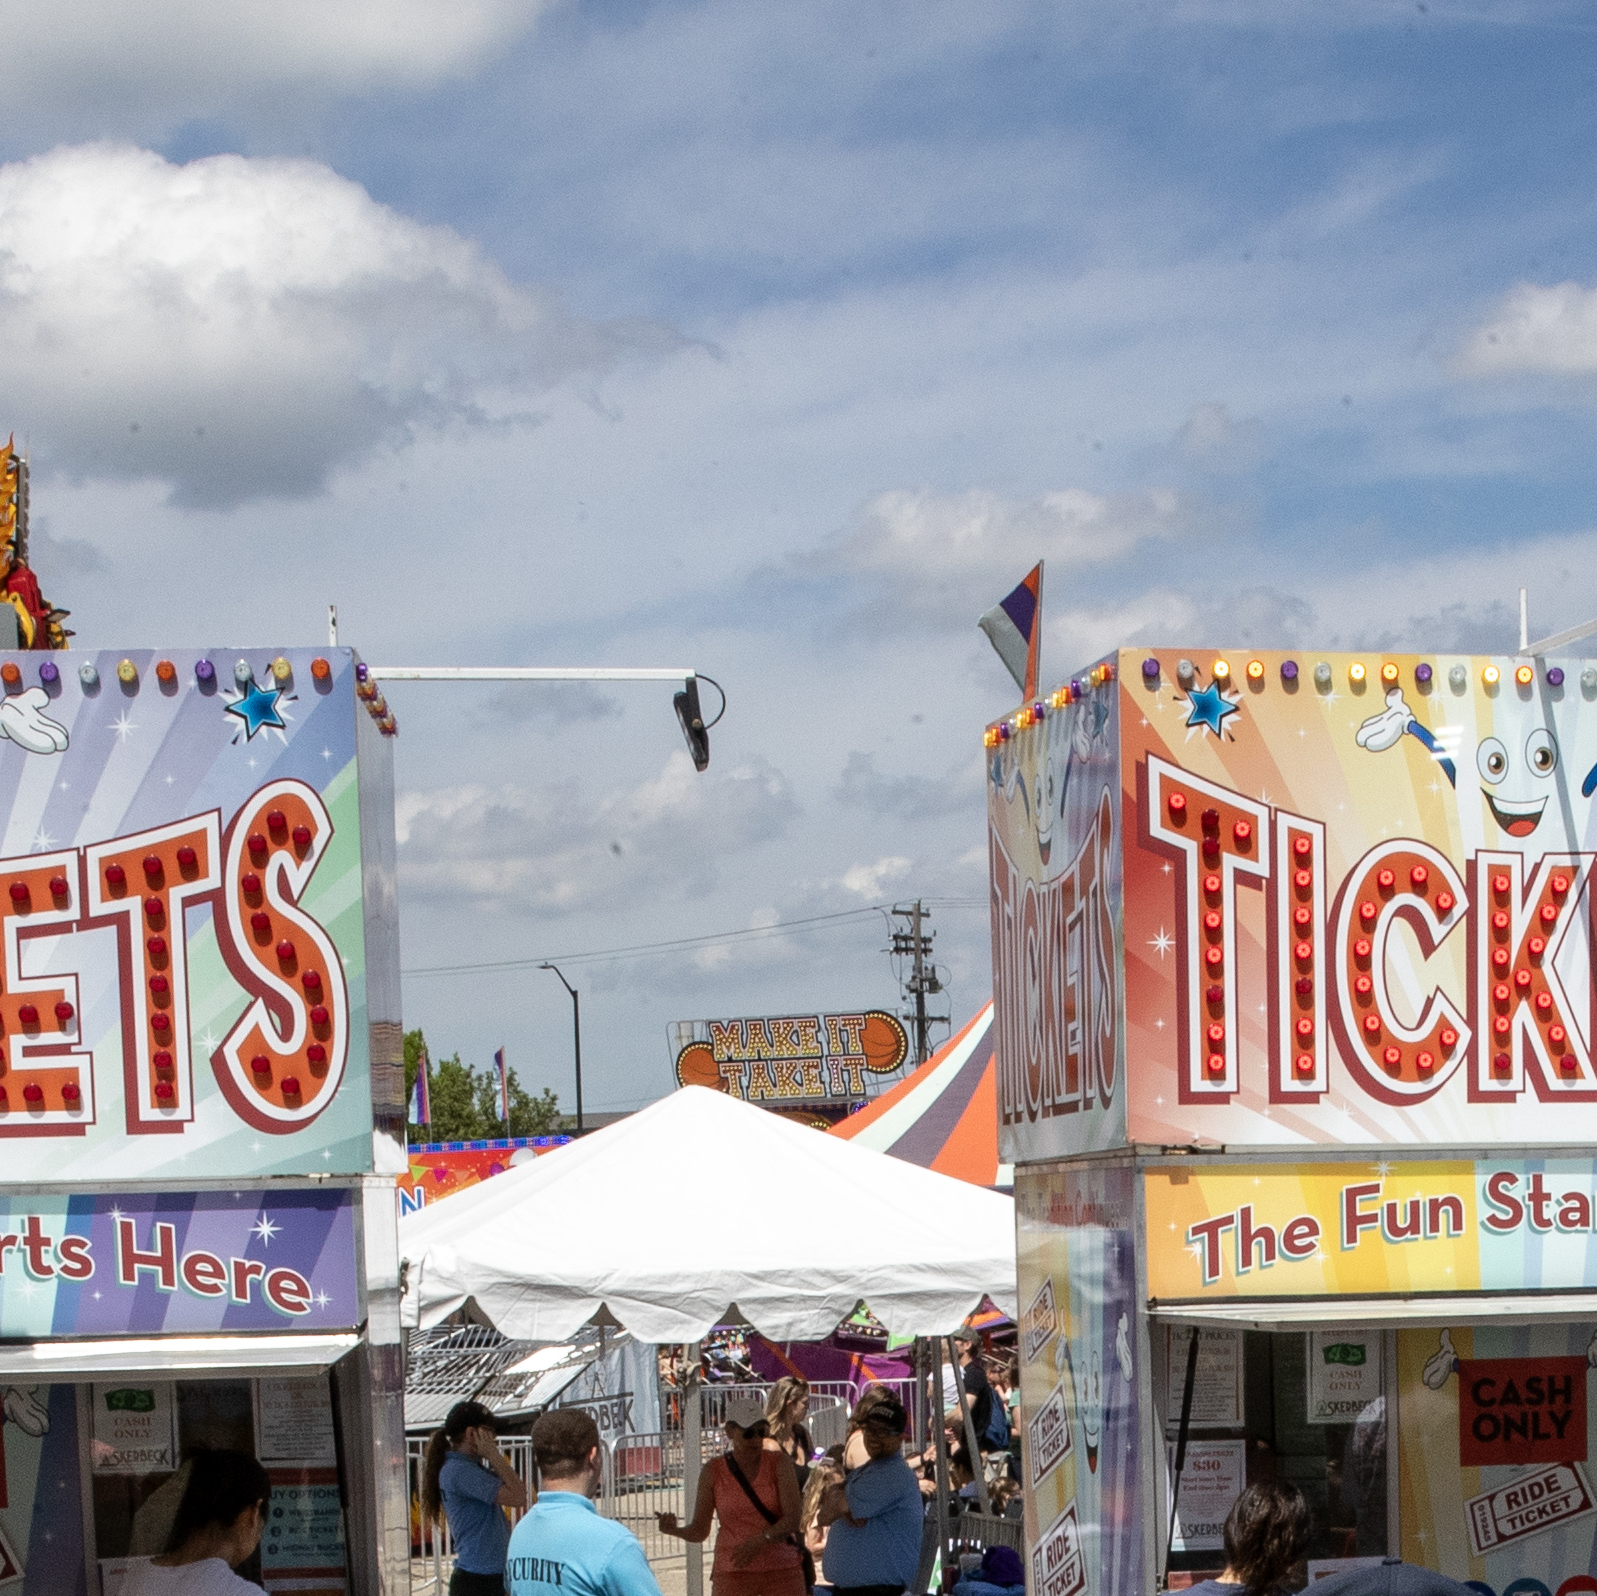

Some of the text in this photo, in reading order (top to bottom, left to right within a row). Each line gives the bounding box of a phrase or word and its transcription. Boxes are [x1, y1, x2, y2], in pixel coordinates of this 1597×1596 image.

[992, 783, 1118, 1127] TICKETS
[709, 1014, 867, 1060] MAKE IT
[721, 1055, 868, 1100] TAKE IT
[1190, 1207, 1320, 1286] The
[1342, 1181, 1464, 1250] Fun
[116, 1214, 313, 1317] Here
[1032, 1295, 1049, 1326] RIDE
[1032, 1317, 1055, 1347] TICKET
[1329, 1381, 1362, 1391] ONLY
[1471, 1375, 1574, 1409] CASH
[113, 1416, 151, 1427] CASH
[113, 1428, 151, 1439] ONLY
[1041, 1403, 1062, 1440] RIDE
[1471, 1409, 1576, 1444] ONLY
[1040, 1431, 1065, 1466] TICKET
[1506, 1473, 1563, 1511] RIDE
[1186, 1522, 1225, 1538] SKERBE
[1506, 1496, 1574, 1532] TICKET
[1045, 1528, 1072, 1571] RIDE
[508, 1557, 565, 1586] ECURITY
